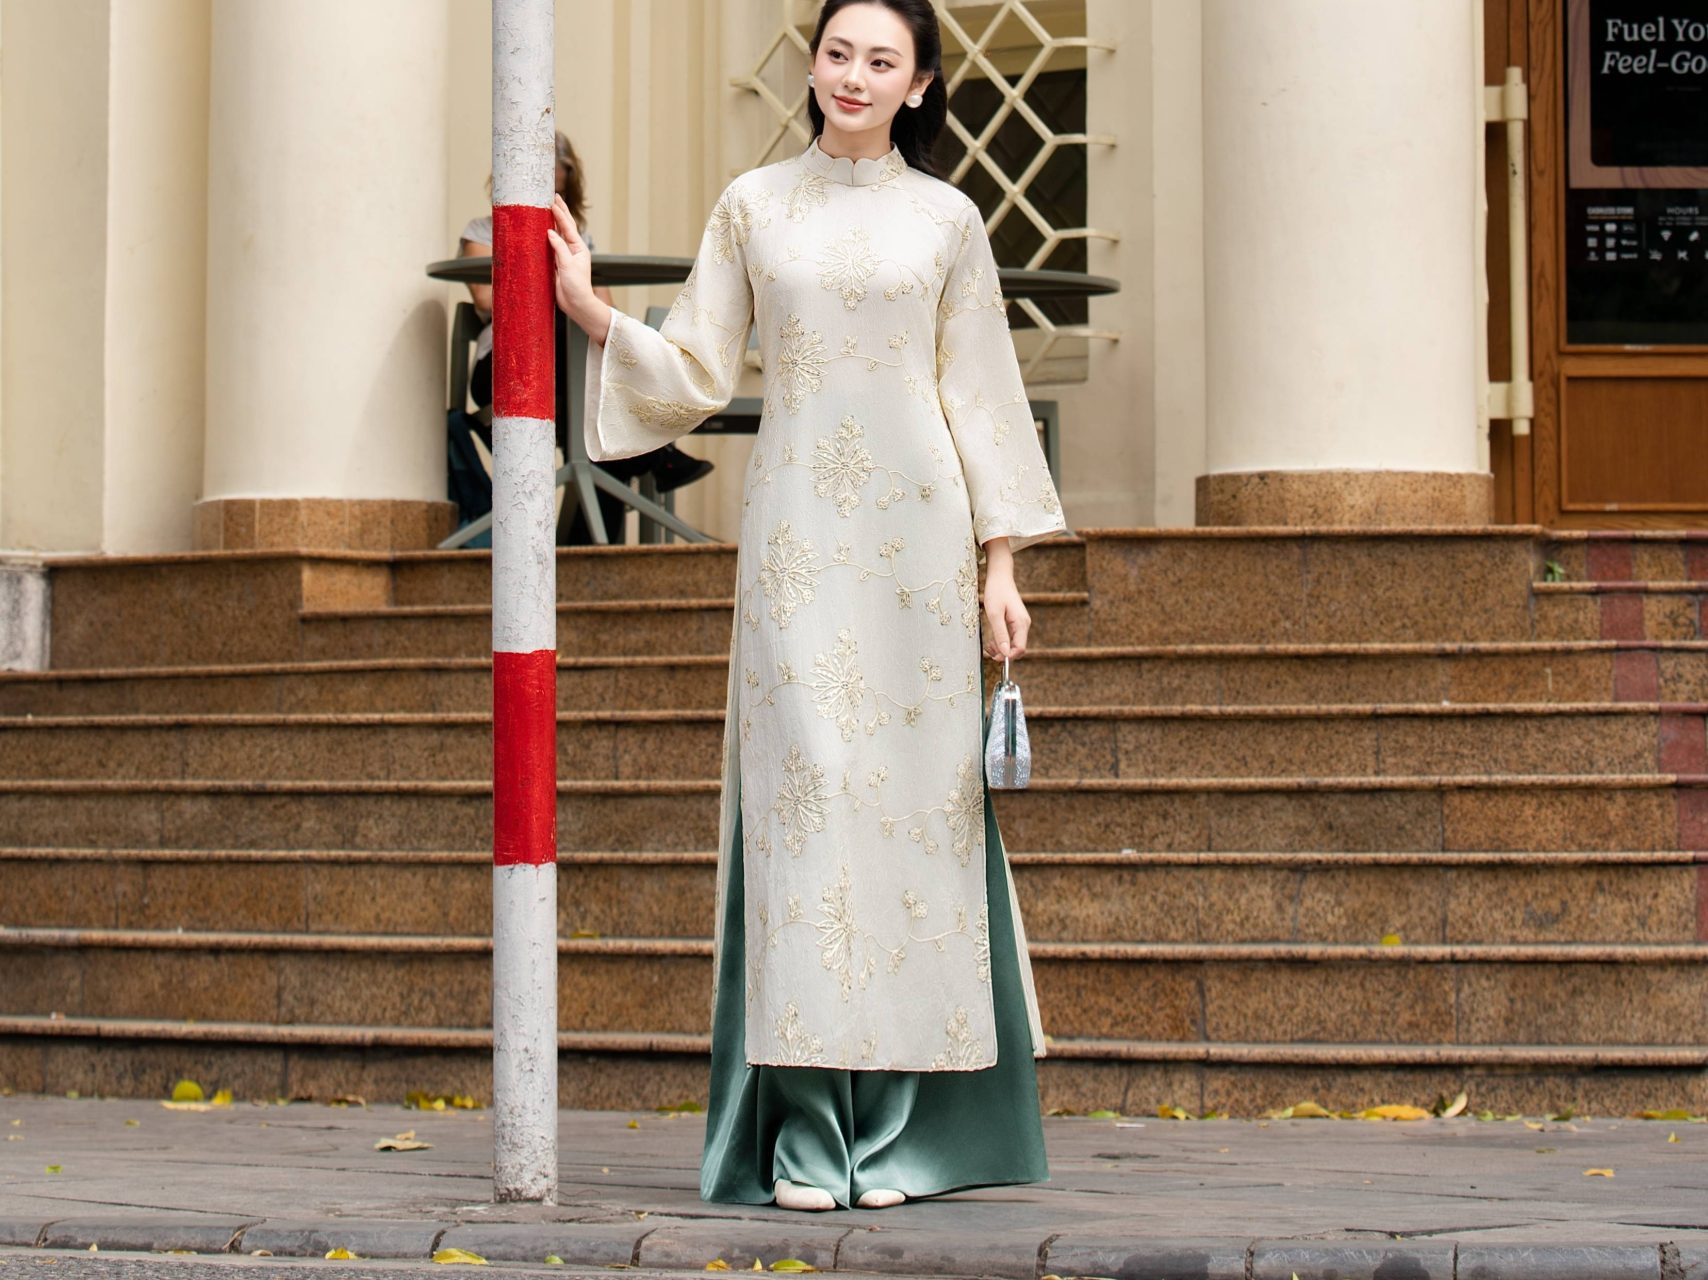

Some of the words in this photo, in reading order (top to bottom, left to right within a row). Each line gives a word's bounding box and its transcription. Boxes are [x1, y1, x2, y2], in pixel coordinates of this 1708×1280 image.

[1606, 16, 1665, 42] Fuel
[1671, 19, 1708, 42] Yo
[1601, 48, 1708, 75] Feel-Go
